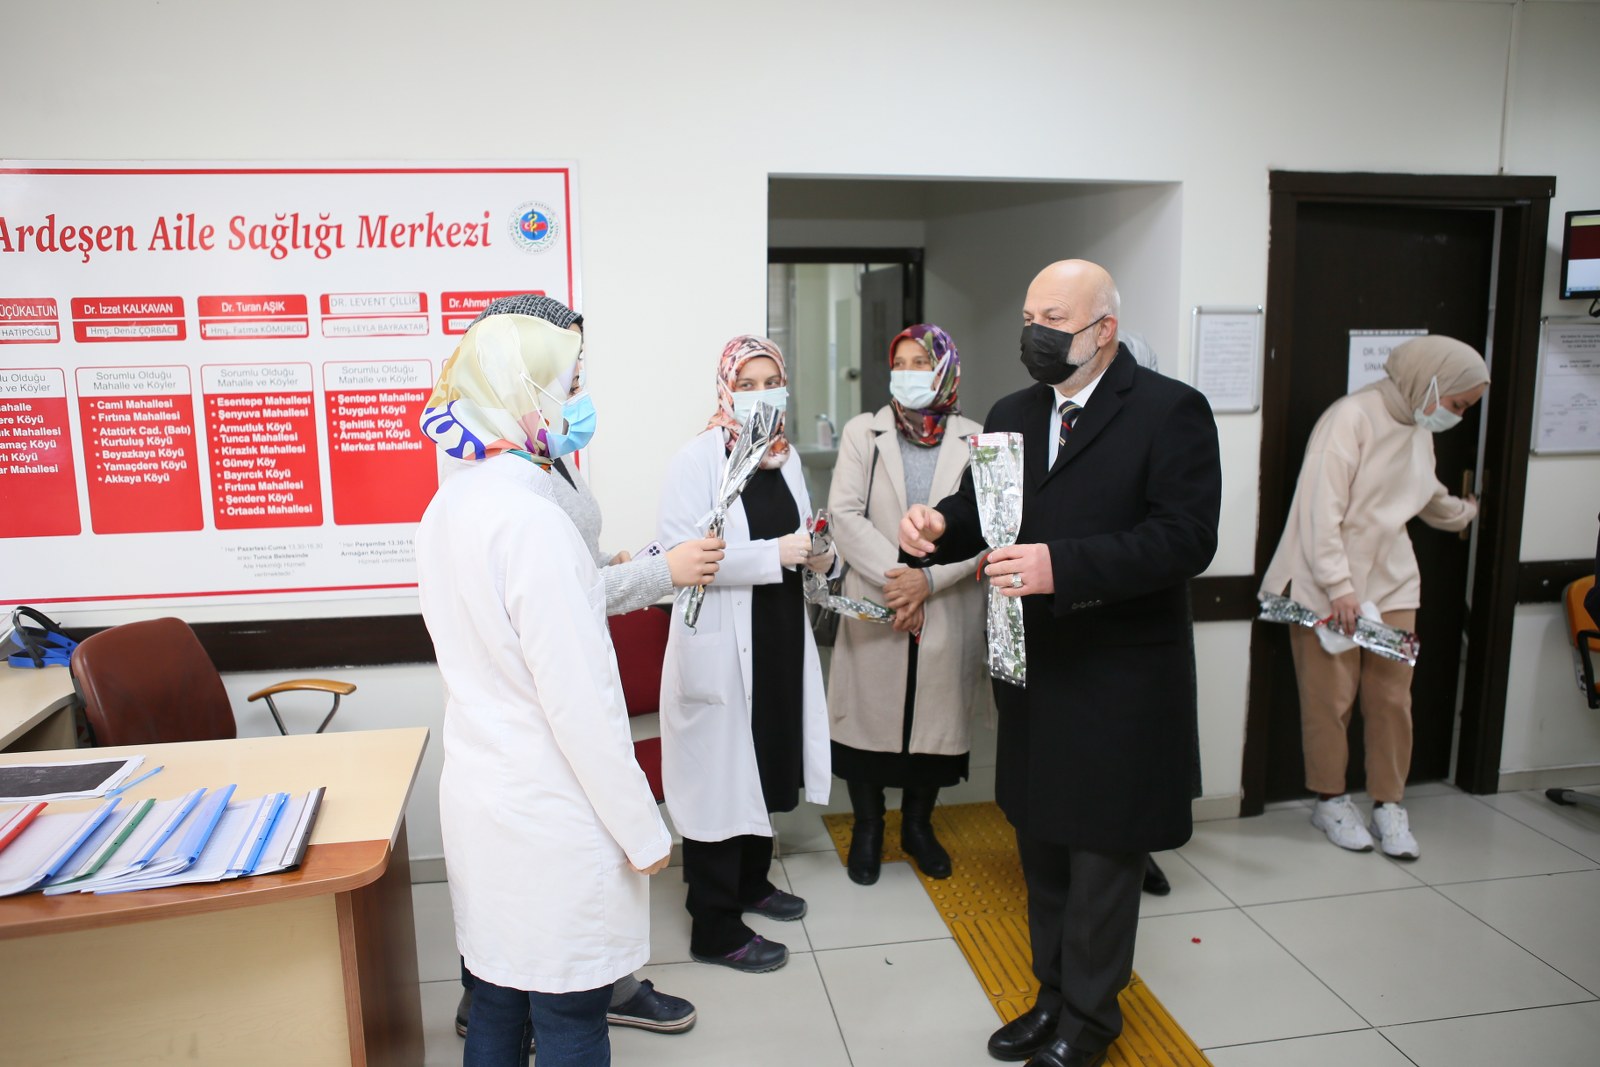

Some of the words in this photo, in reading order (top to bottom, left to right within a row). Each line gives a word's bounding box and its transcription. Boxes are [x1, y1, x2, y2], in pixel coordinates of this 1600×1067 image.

[0, 213, 137, 263] Ardeşen
[147, 212, 215, 251] Aile
[228, 212, 345, 260] Sağlığı
[356, 210, 492, 249] Merkezi
[221, 302, 235, 313] Dr.
[236, 301, 261, 312] Turan
[262, 300, 286, 314] AŞIK
[330, 297, 347, 308] DR.
[350, 296, 386, 307] LEVENT
[389, 295, 418, 307] ÇİLLİK
[448, 297, 462, 309] Dr.
[463, 297, 490, 308] Ahmet
[83, 304, 97, 315] Dr.
[99, 302, 121, 315] İzzet
[122, 303, 174, 314] KALKAVAN
[2, 326, 51, 337] HATİPOĞLU
[90, 327, 112, 338] Hmş.
[114, 326, 137, 335] Deniz
[378, 323, 424, 333] BAYRAKTAR
[96, 371, 135, 380] Sorumlu
[138, 370, 172, 380] Olduğu
[220, 368, 258, 378] Sorumlu
[261, 367, 295, 377] Olduğu
[341, 365, 379, 375] Sorumlu
[381, 364, 414, 375] Olduğu
[11, 373, 46, 383] Olduğu
[217, 378, 253, 388] Mahalle
[256, 379, 267, 387] ve
[269, 377, 298, 388] Köyler
[338, 375, 374, 385] Mahalle
[376, 376, 387, 384] ve
[389, 373, 418, 385] Köyler
[6, 385, 17, 393] ve
[20, 384, 51, 394] Köyler
[93, 381, 130, 391] Mahalle
[133, 382, 144, 390] ve
[147, 380, 176, 391] Köyler
[97, 399, 123, 410] Cami
[125, 398, 173, 409] Mahallesi
[217, 397, 263, 408] Esentepe
[264, 395, 311, 406] Mahallesi
[338, 394, 377, 405] Şentepe
[379, 392, 425, 402] Mahallesi
[98, 412, 131, 422] Fırtına
[133, 410, 181, 421] Mahallesi
[218, 409, 260, 420] Şenyuva
[262, 407, 309, 418] Mahallesi
[338, 407, 379, 418] Duygulu
[381, 405, 407, 416] Köyü
[17, 415, 44, 426] Köyü
[339, 420, 376, 431] Şehitlik
[377, 418, 403, 430] Köyü
[13, 426, 61, 437] Mahallesi
[99, 427, 137, 437] Atatürk
[139, 426, 162, 435] Cad.
[164, 425, 192, 436] (Batı)
[219, 423, 265, 433] Armutluk
[266, 421, 293, 434] Köyü
[220, 434, 250, 443] Tunca
[252, 431, 299, 442] Mahallesi
[340, 430, 386, 441] Armağan
[385, 429, 411, 440] Köyü
[29, 440, 57, 451] Köyü
[100, 437, 145, 448] Kurtuluş
[146, 435, 173, 447] Köyü
[341, 442, 376, 452] Merkez
[377, 440, 423, 451] Mahallesi
[102, 449, 156, 461] Beyazkaya
[158, 448, 185, 459] Köyü
[221, 446, 259, 456] Kirazlık
[260, 444, 306, 454] Mahallesi
[11, 452, 39, 463] Köyü
[222, 458, 254, 469] Güney
[256, 457, 277, 468] Köy
[10, 463, 59, 474] Mahallesi
[103, 461, 159, 473] Yamaçdere
[161, 460, 188, 471] Köyü
[104, 474, 141, 485] Akkaya
[143, 472, 170, 484] Köyü
[223, 470, 264, 481] Bayırcık
[265, 469, 292, 480] Köyü
[224, 483, 257, 492] Fırtına
[258, 480, 304, 491] Mahallesi
[225, 494, 266, 505] Şendere
[267, 493, 294, 504] Köyü
[226, 506, 266, 516] Ortaada
[267, 504, 313, 514] Mahallesi
